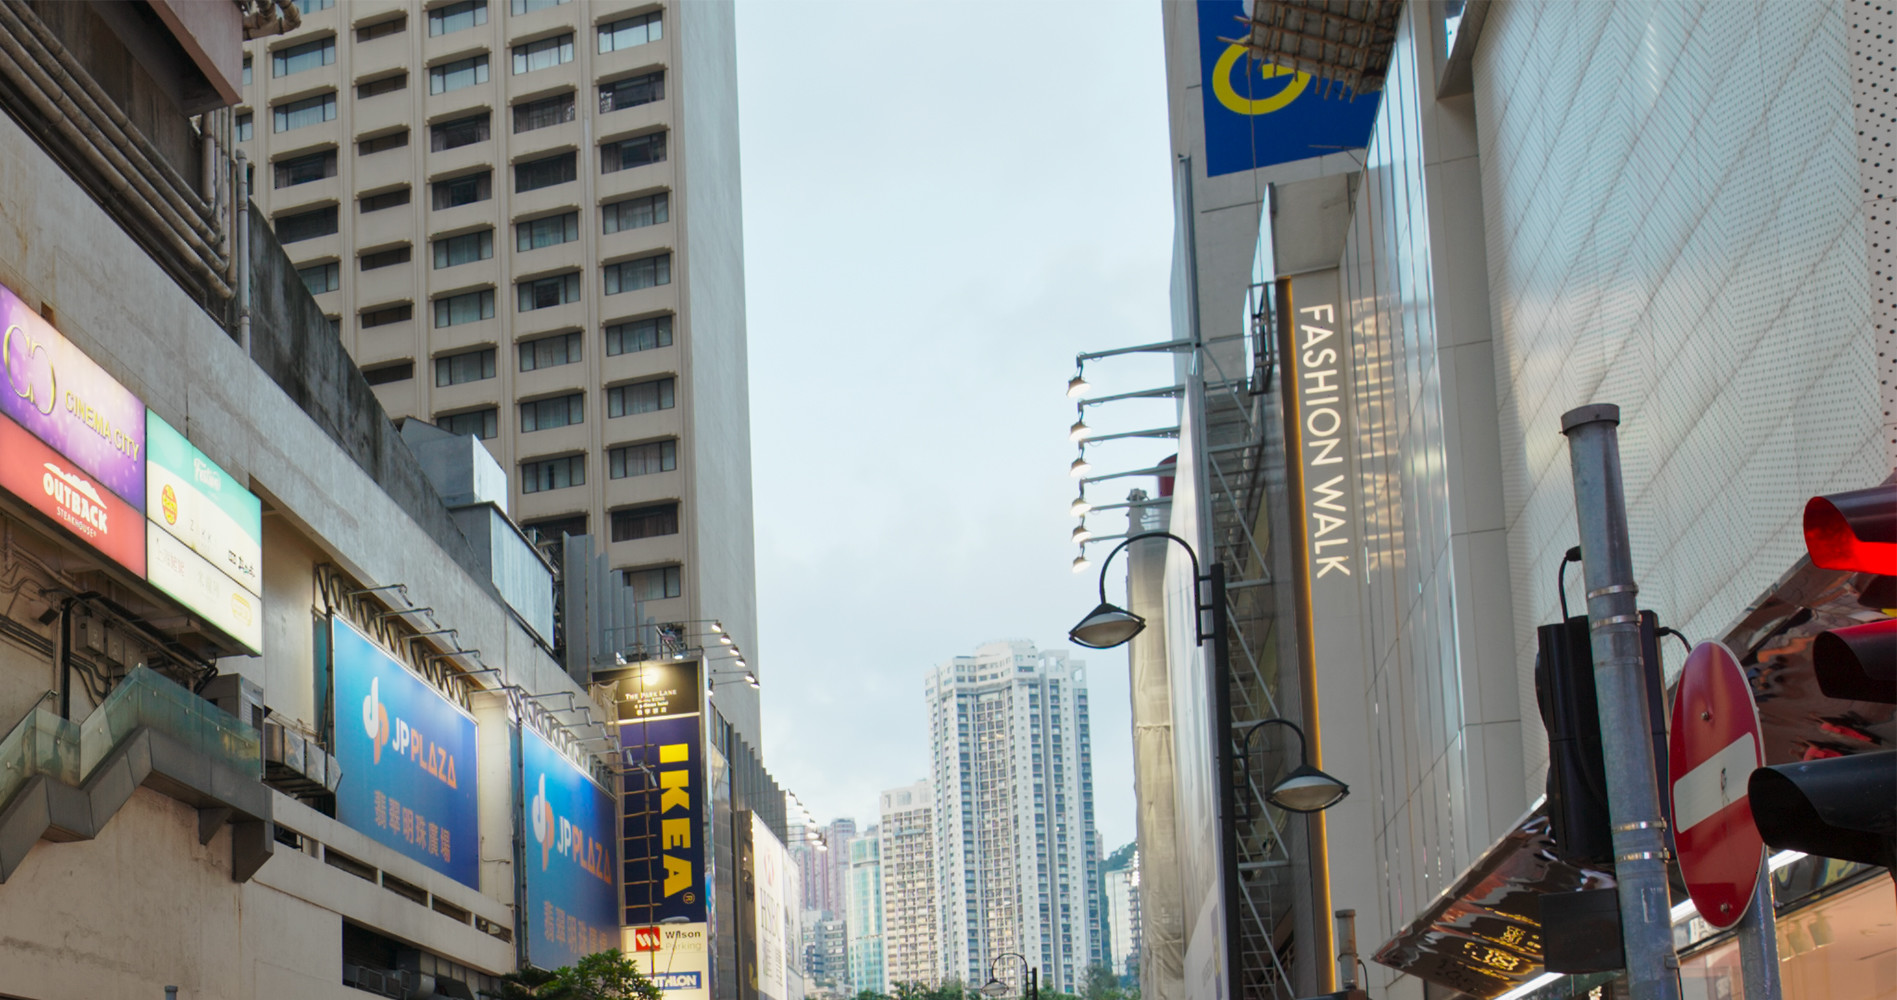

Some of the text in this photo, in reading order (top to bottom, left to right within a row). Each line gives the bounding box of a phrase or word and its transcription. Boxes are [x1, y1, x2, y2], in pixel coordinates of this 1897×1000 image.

[65, 390, 140, 462] CINEMA CITY
[1300, 303, 1351, 579] FASHION WALK
[43, 473, 108, 535] OUTBACK
[392, 717, 457, 789] JP PLAZA
[557, 816, 612, 885] JP PLAZA
[665, 930, 701, 939] Wilson
[665, 942, 702, 951] Parking
